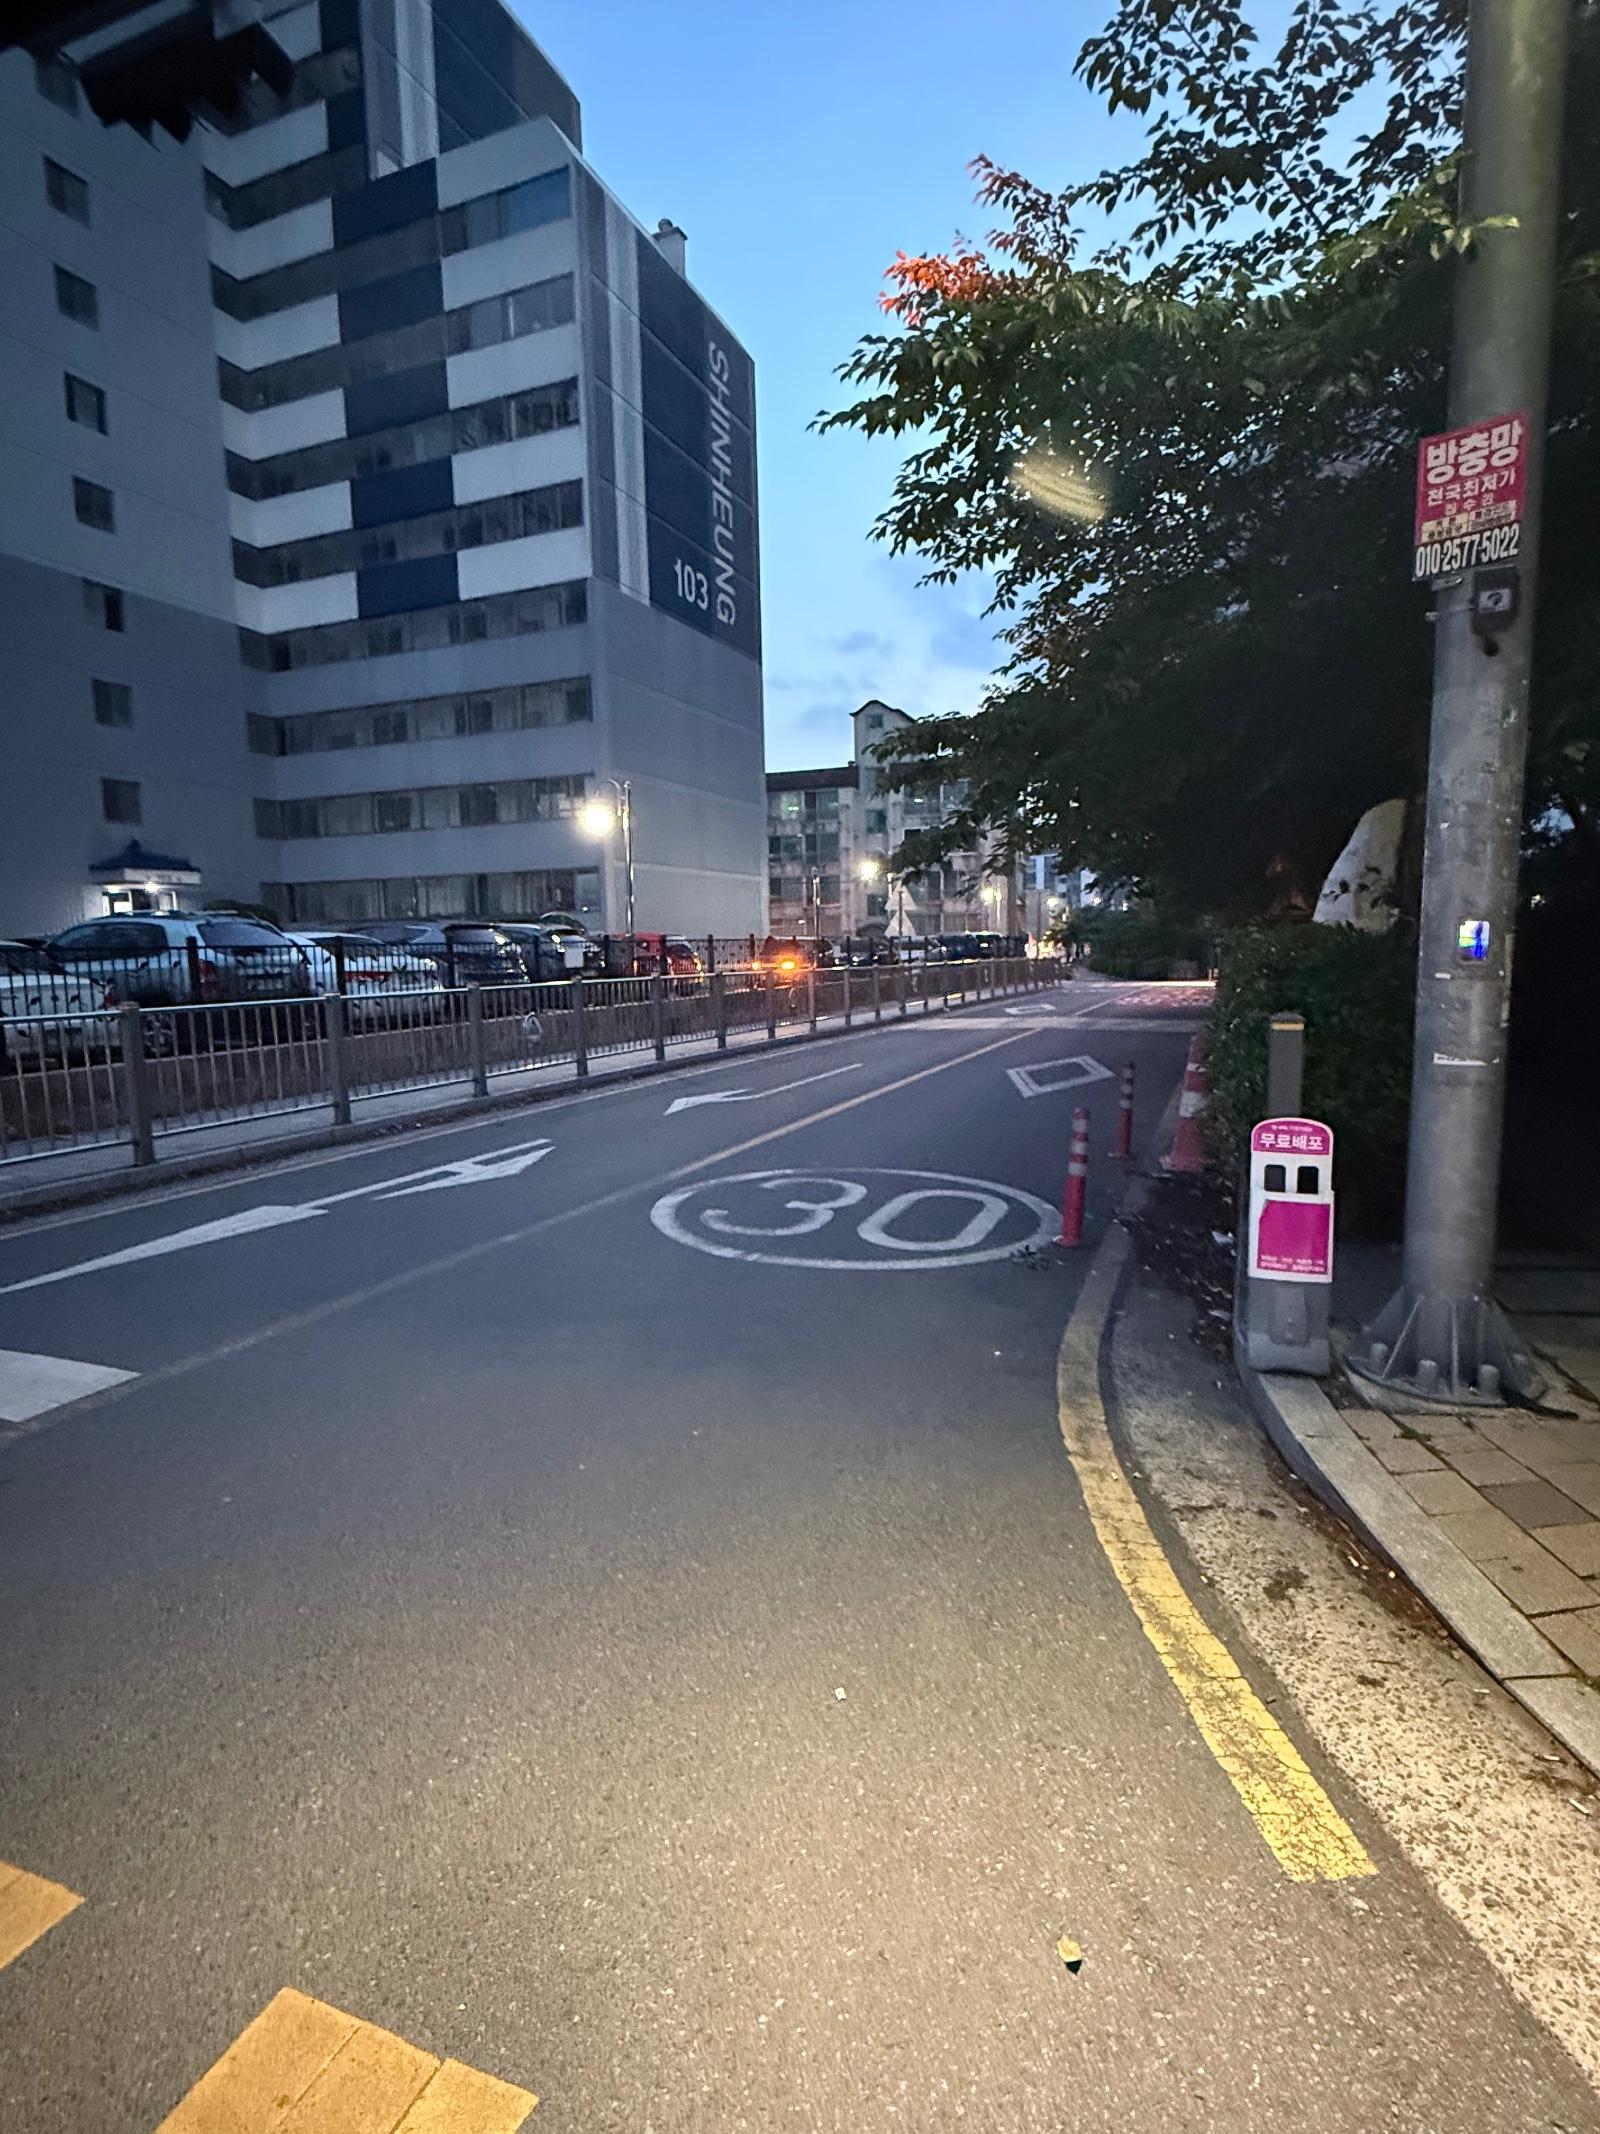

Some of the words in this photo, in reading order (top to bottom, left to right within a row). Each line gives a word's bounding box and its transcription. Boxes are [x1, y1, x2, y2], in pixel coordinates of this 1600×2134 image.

[1426, 419, 1522, 485] 방충망
[709, 341, 737, 626] SHINHEUNG
[1414, 522, 1520, 578] 010-2577-5022
[674, 558, 708, 610] 103
[1259, 1132, 1324, 1151] 무료배포
[700, 1177, 1008, 1252] 30
